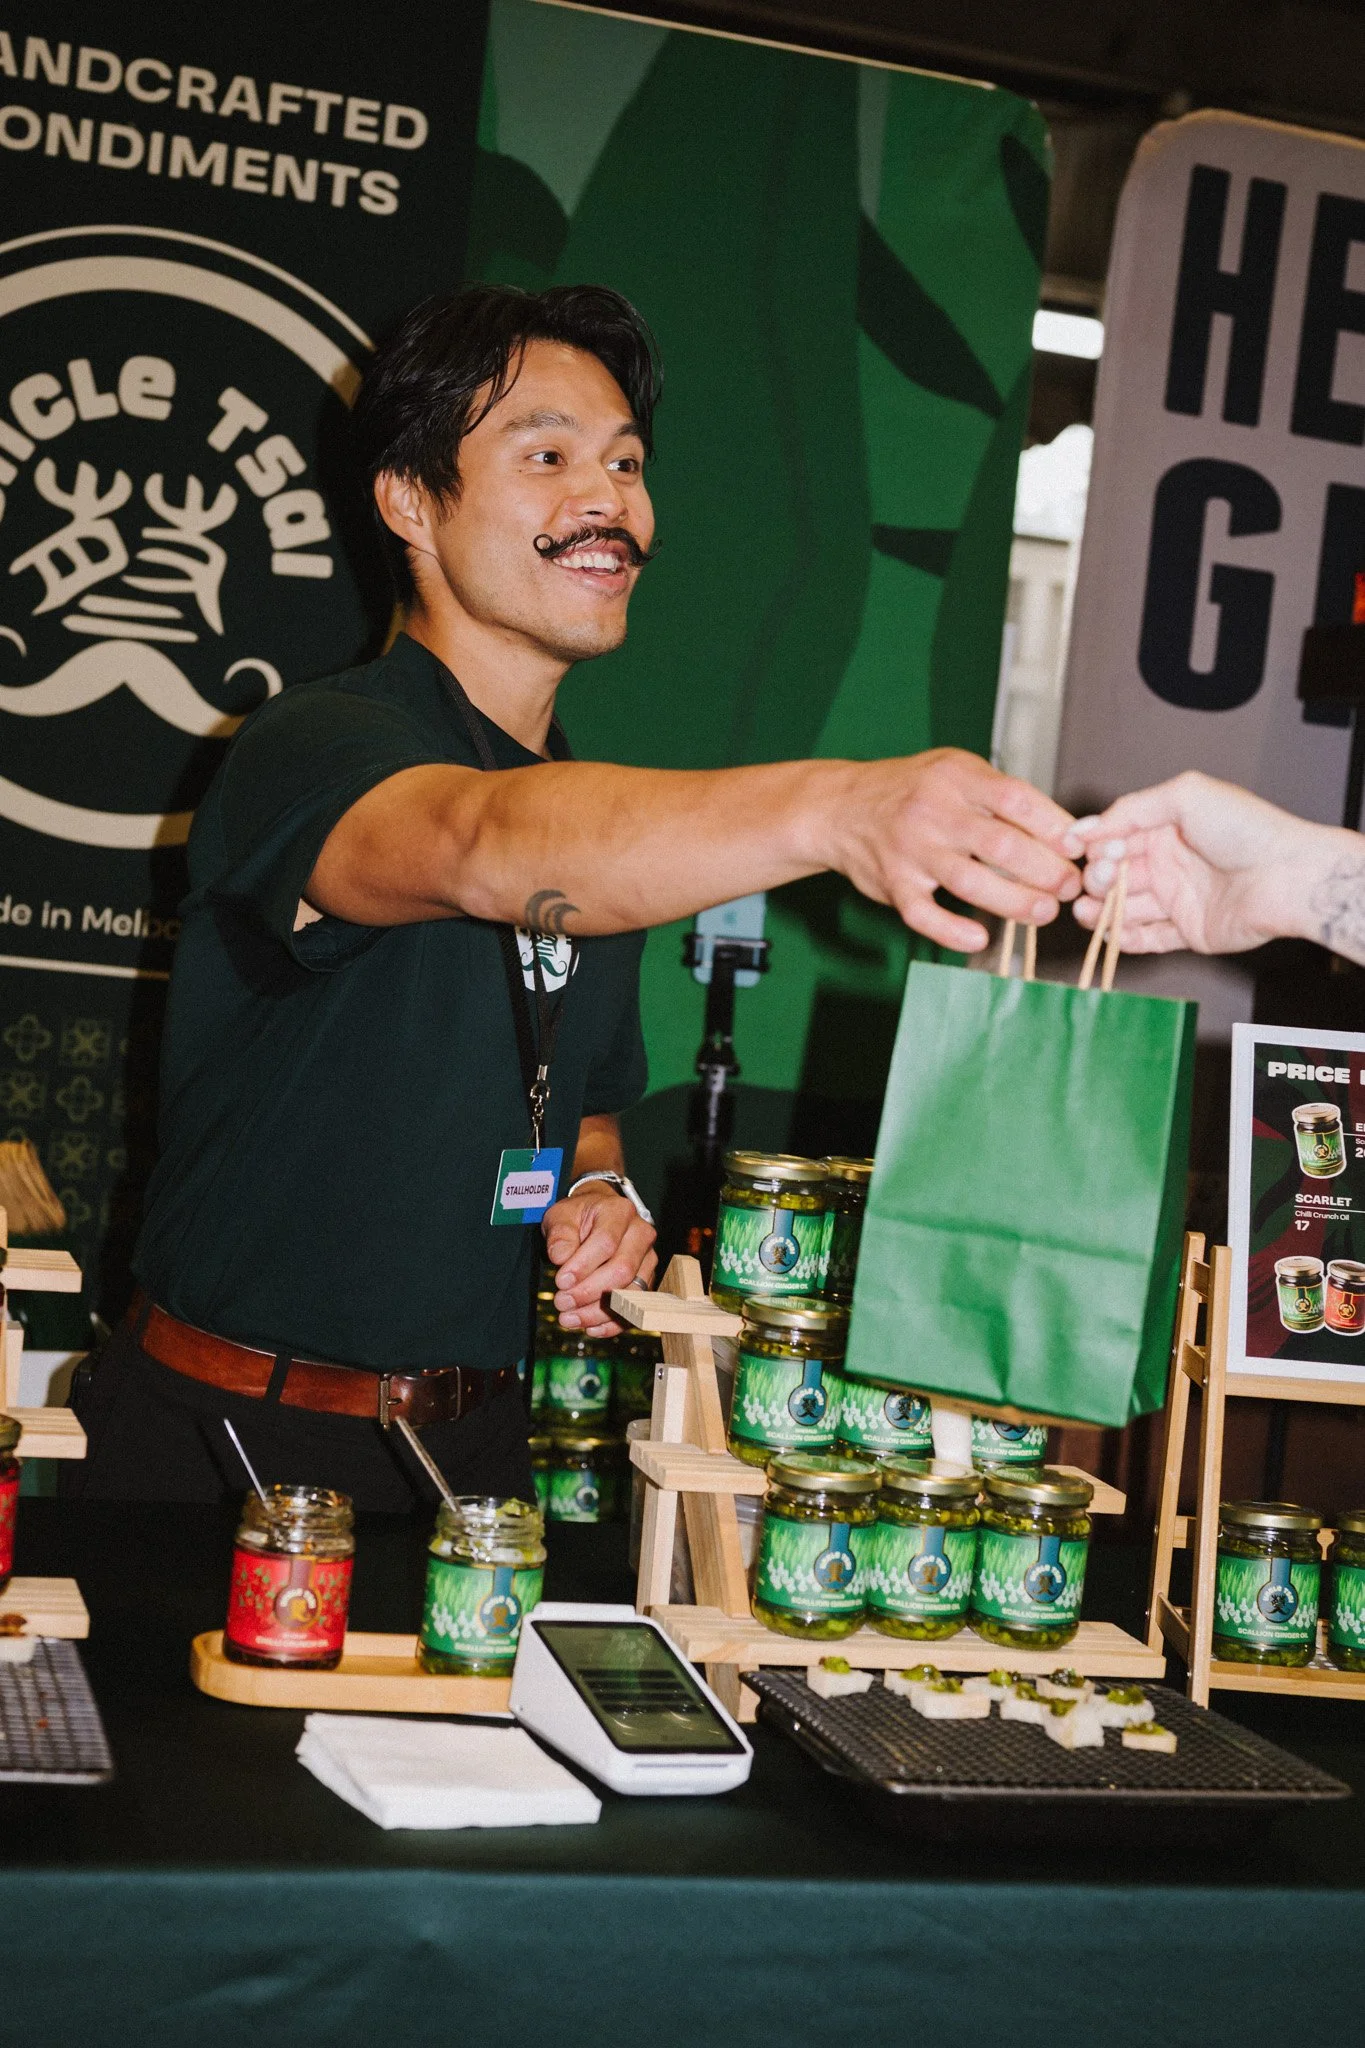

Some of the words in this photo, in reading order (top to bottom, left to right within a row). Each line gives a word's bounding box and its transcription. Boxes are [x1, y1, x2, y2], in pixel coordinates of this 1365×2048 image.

[0, 105, 401, 216] ONDIMENTS
[41, 900, 72, 932] in
[1267, 1061, 1351, 1084] PRICE
[505, 1184, 550, 1196] STALLHOLDER
[1295, 1193, 1352, 1207] SCARLET
[1313, 1212, 1339, 1220] Crunch
[1295, 1220, 1310, 1231] 17
